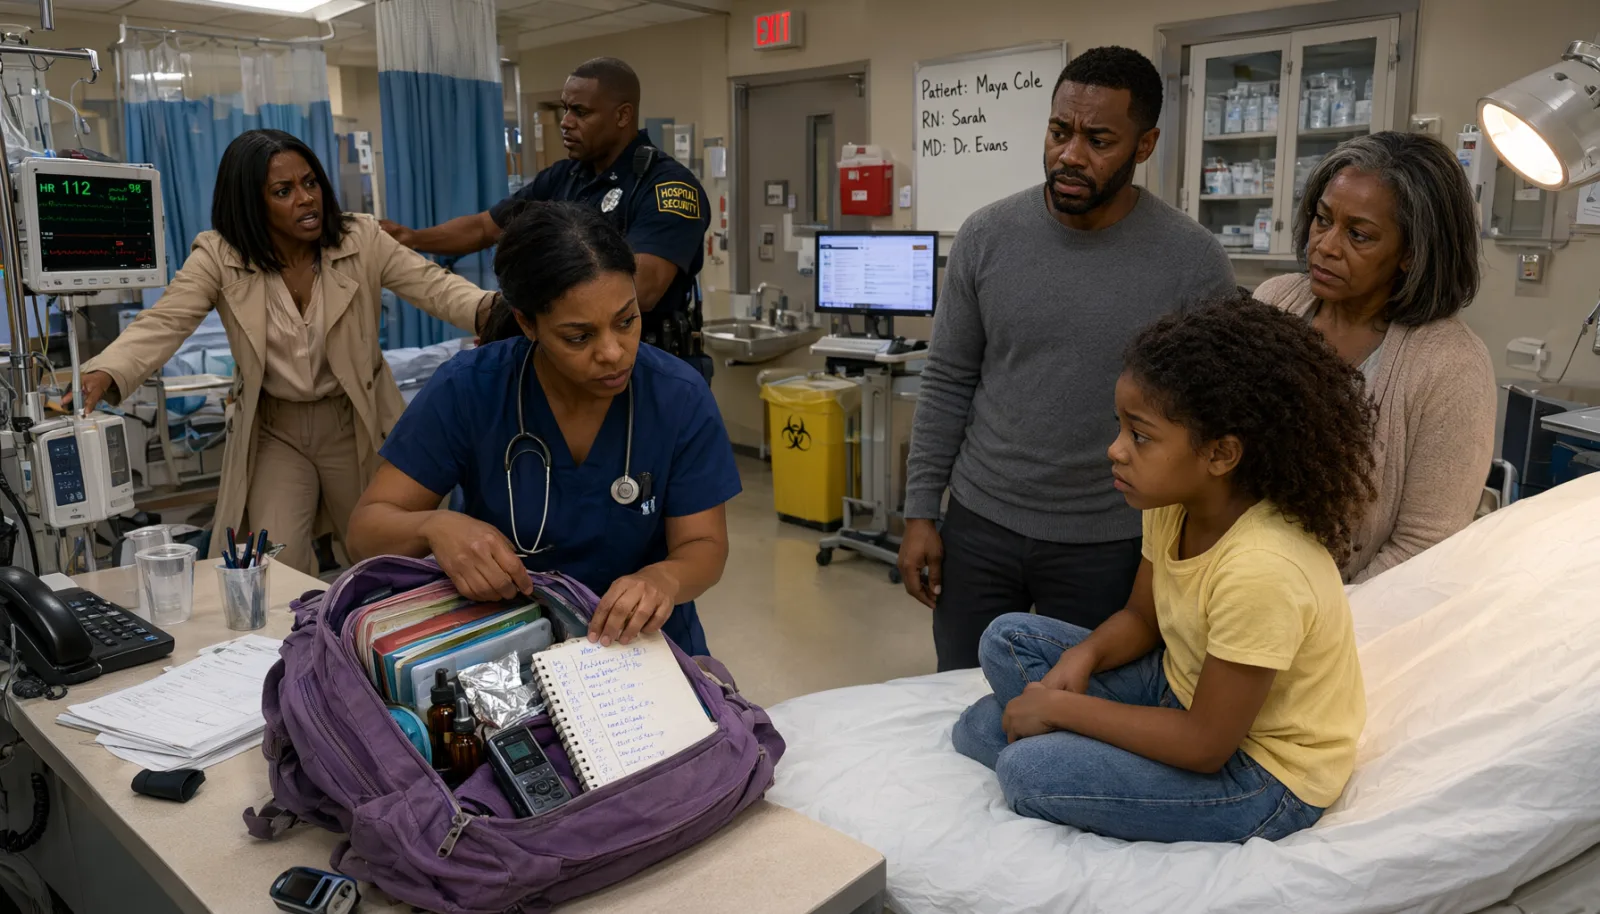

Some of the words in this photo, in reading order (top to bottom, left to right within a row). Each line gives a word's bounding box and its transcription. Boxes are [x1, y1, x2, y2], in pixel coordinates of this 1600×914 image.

[757, 11, 791, 46] EXIT
[922, 79, 967, 100] Patient:
[976, 74, 1008, 100] Maya
[1014, 71, 1043, 90] Cole
[922, 110, 945, 129] RN:
[952, 107, 987, 126] Sarah
[922, 138, 946, 157] MD:
[953, 137, 971, 155] Dr.
[976, 135, 1008, 153] Evans
[39, 183, 56, 193] HR
[62, 180, 92, 196] 112
[128, 183, 142, 194] 98
[660, 187, 697, 202] HOSPITAL
[662, 198, 697, 214] SECURITY
